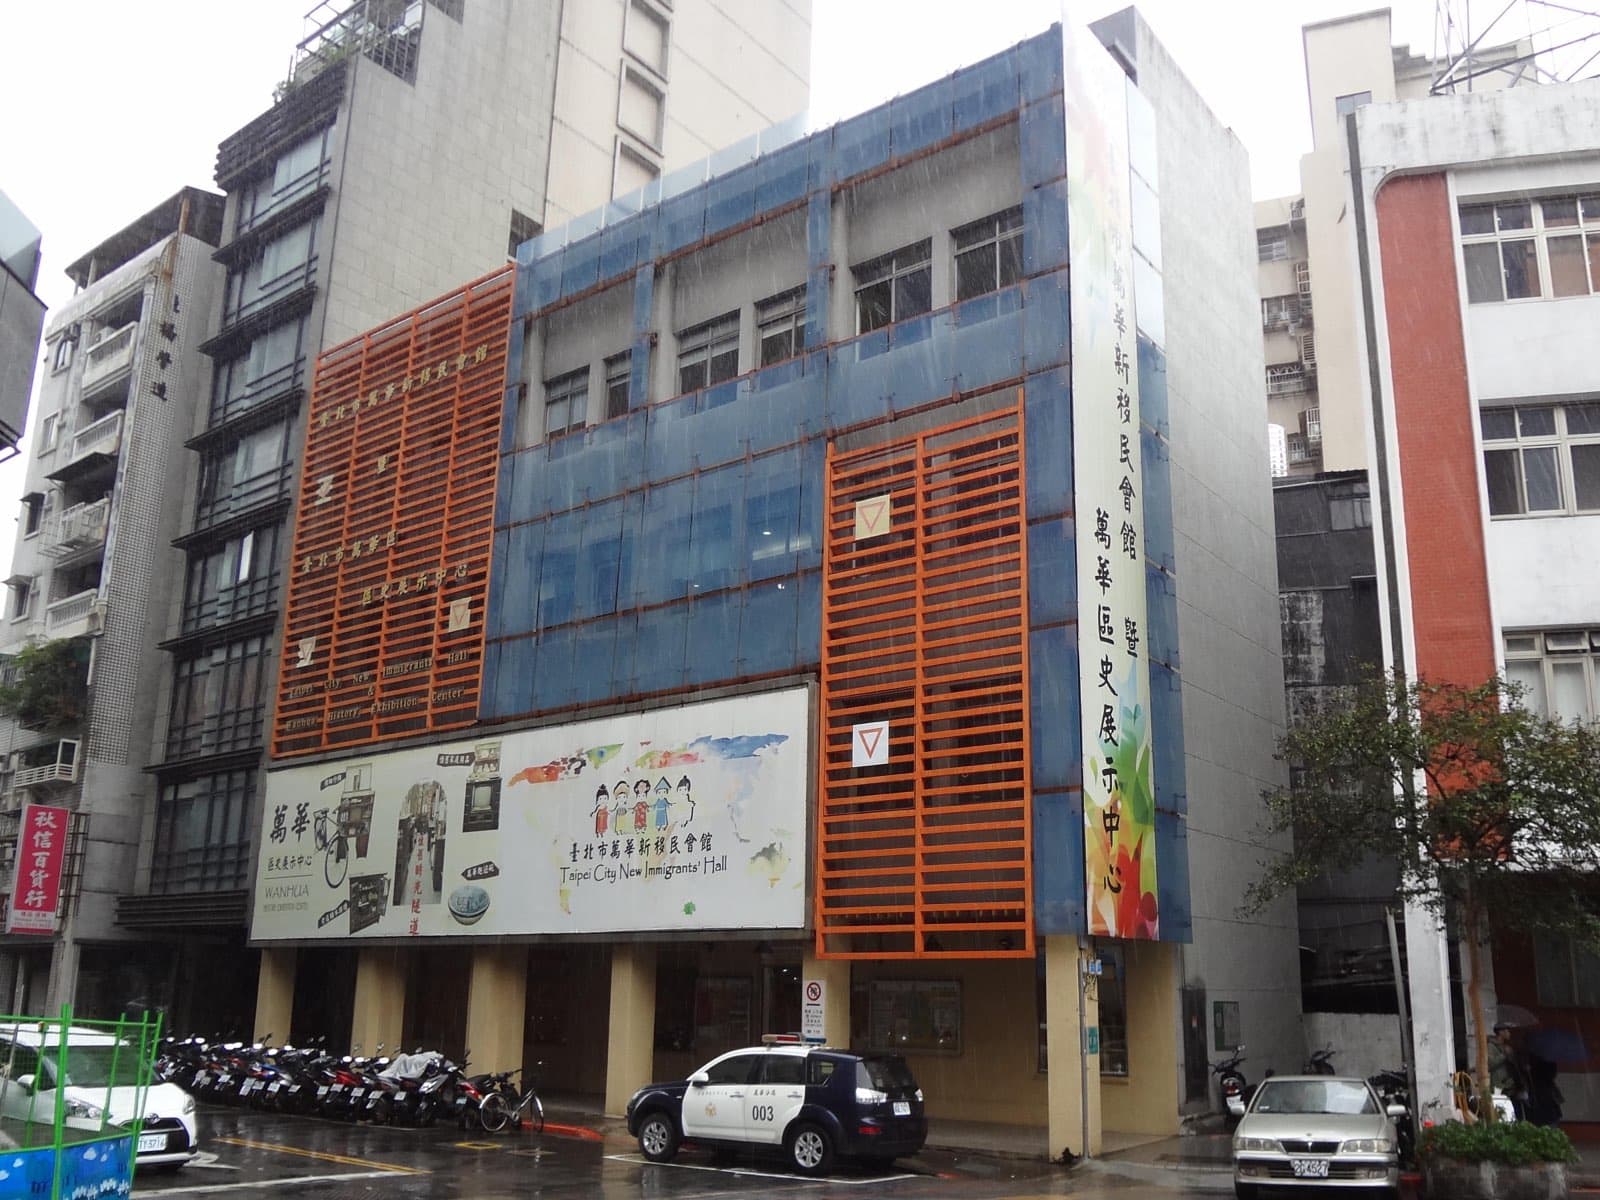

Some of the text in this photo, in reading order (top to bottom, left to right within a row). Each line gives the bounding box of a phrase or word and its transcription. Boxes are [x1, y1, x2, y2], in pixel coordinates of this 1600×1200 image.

[448, 651, 468, 664] Hall
[432, 688, 463, 704] Center
[1094, 507, 1122, 893] 萬華區史展示中心
[270, 802, 310, 844] 萬華
[25, 811, 57, 908] 秋信百貨行
[569, 832, 713, 862] 臺北市萬華新移民會館
[560, 855, 728, 886] Taipei City New Immigrants' Hall
[265, 884, 309, 899] WANHUA
[752, 1105, 774, 1121] 003
